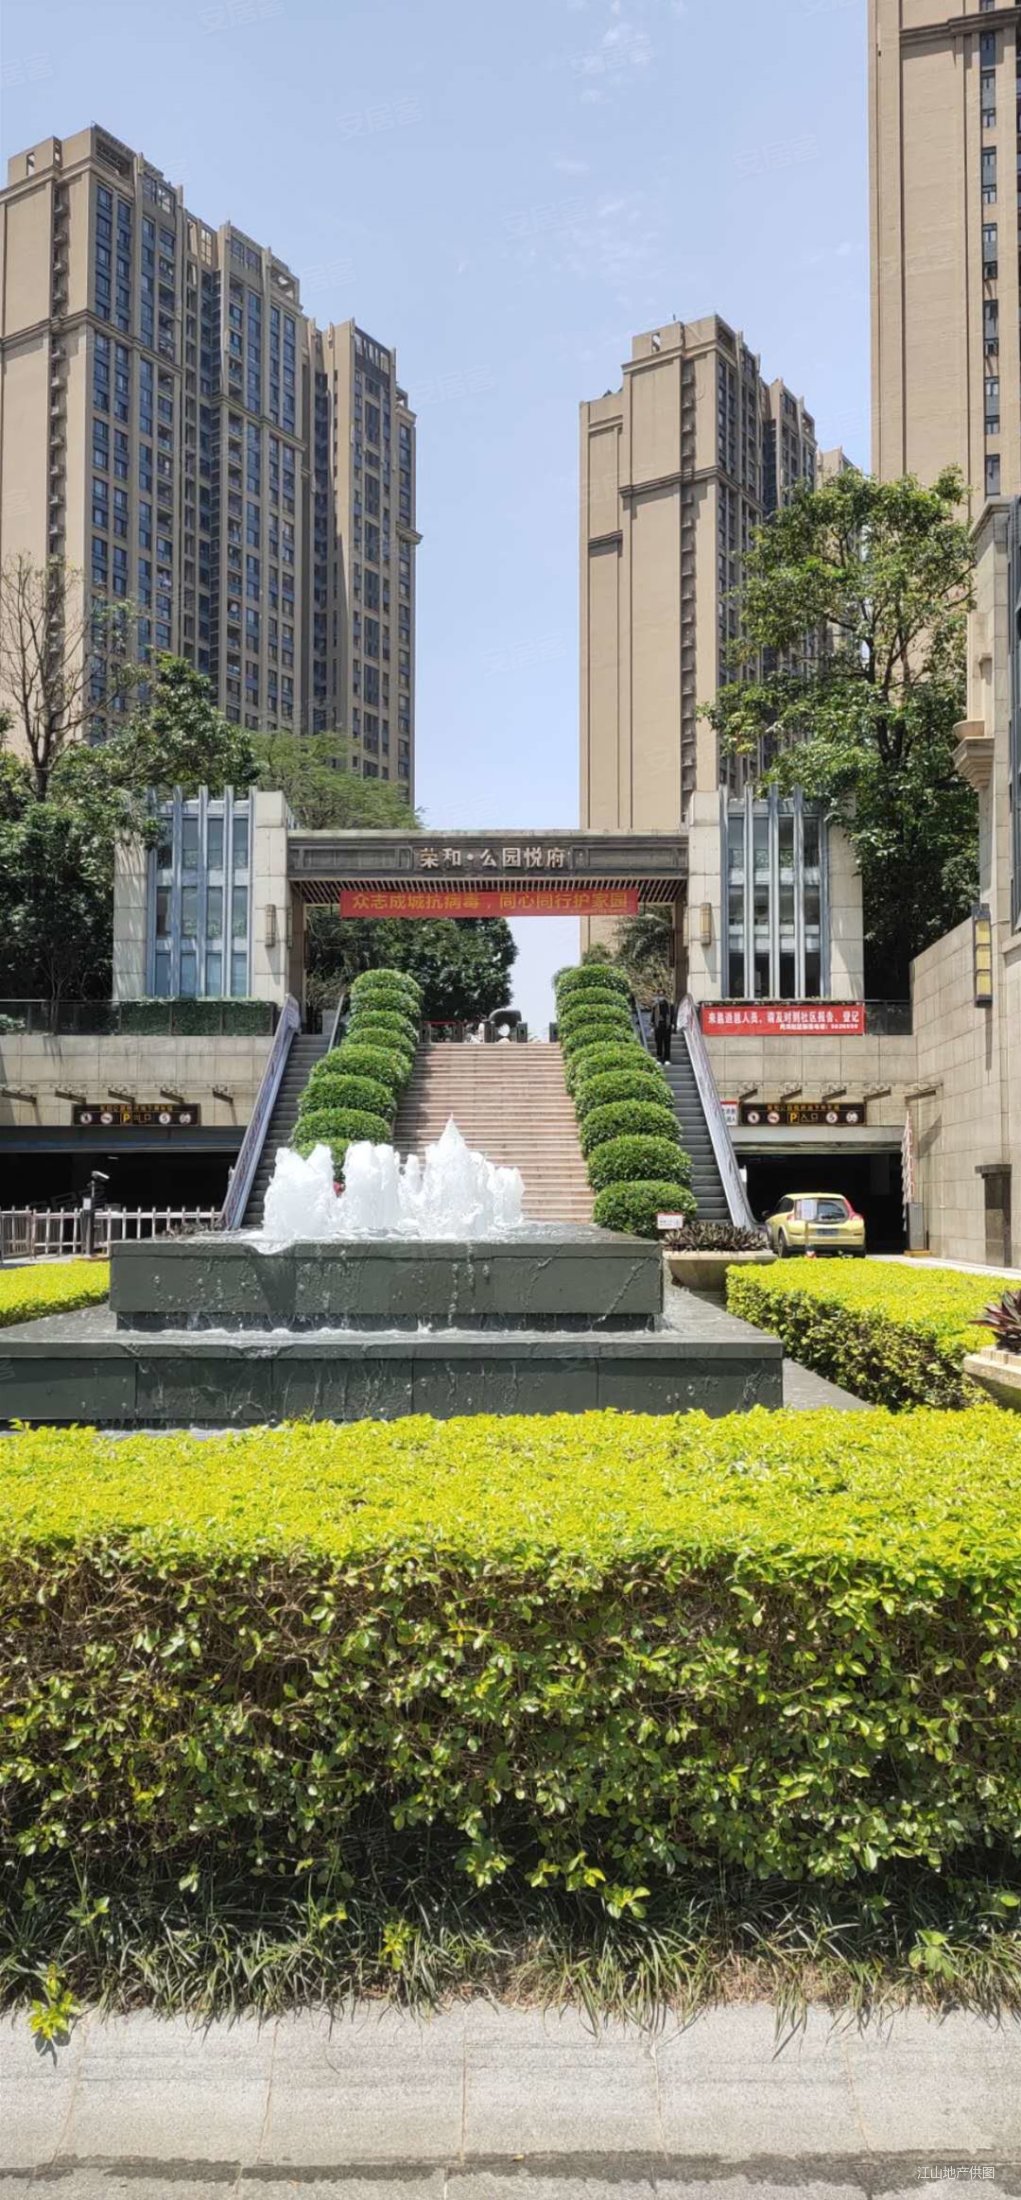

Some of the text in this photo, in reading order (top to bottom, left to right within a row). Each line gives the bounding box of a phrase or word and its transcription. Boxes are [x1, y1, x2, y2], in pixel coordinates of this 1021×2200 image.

[420, 847, 566, 869] 荣和·公园悦府
[353, 892, 628, 911] 众志成城抗病毒，同心同行护家园
[790, 1112, 798, 1122] P
